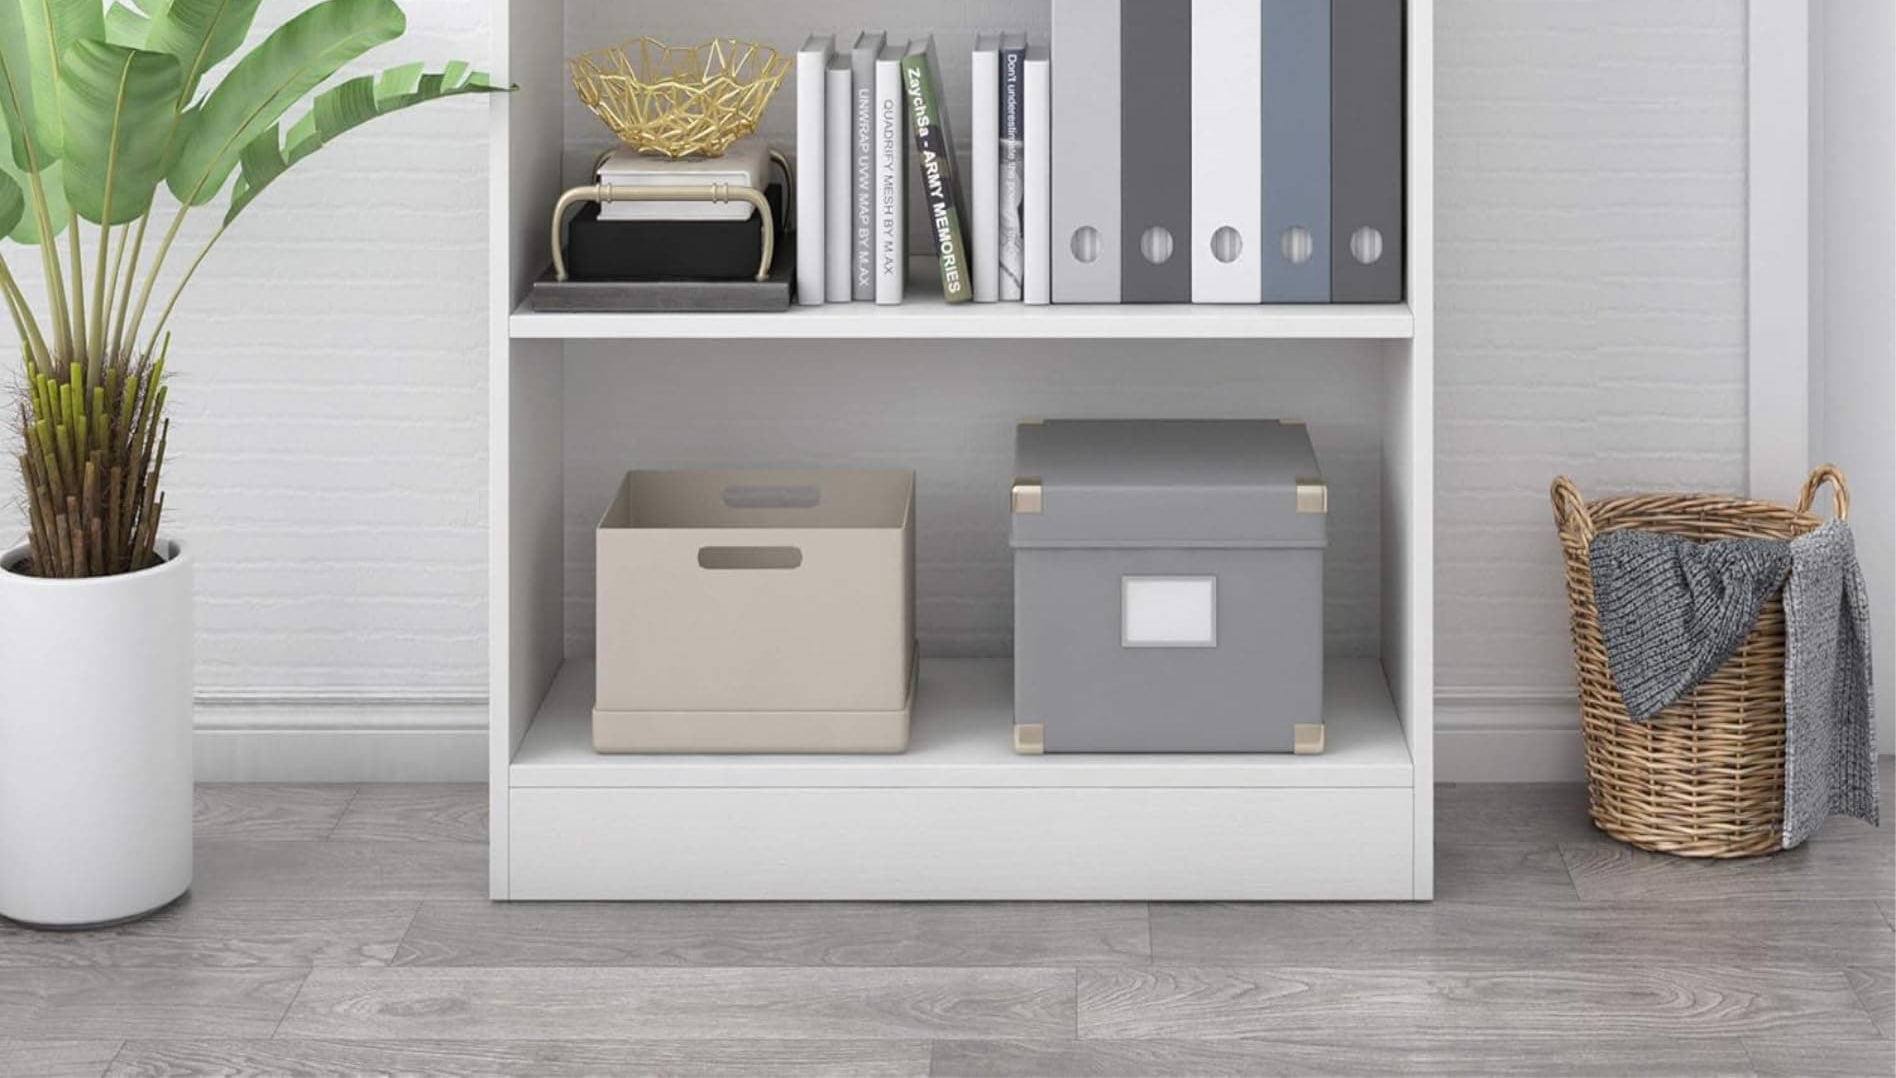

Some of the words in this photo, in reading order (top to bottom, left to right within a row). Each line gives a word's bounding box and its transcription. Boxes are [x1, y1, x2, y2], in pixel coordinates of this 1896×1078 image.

[1007, 54, 1018, 82] Don't
[858, 88, 871, 153] UNWRAP
[883, 98, 894, 171] QUADRIFY
[858, 155, 871, 189] UVW
[922, 150, 944, 198] ARMY
[858, 193, 871, 224] MAP
[883, 175, 894, 215] MESH
[858, 227, 871, 248] BY
[883, 218, 894, 238] BY
[932, 203, 961, 294] MEMORIES
